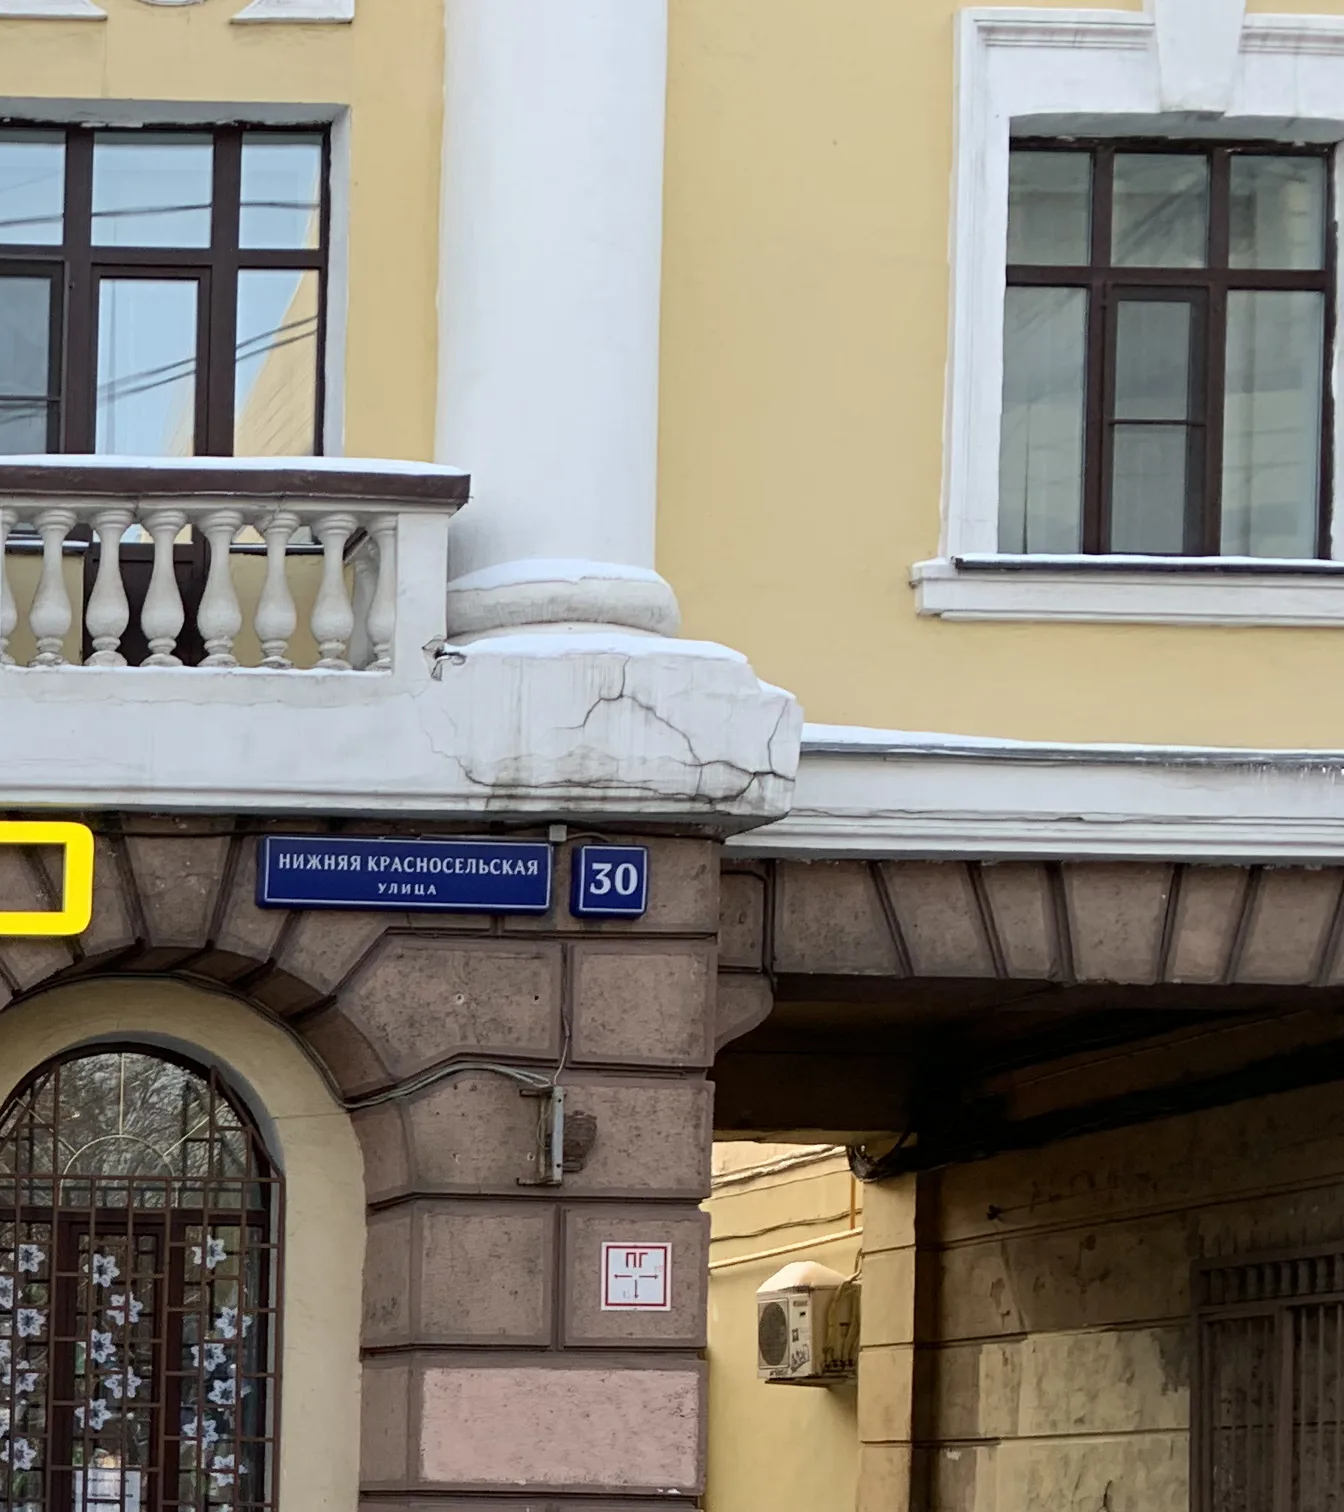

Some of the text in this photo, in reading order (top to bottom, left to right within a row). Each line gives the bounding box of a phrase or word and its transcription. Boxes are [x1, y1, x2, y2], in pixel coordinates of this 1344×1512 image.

[279, 853, 539, 876] НИЖНЯЯ КРАСНОСЕЛЬСКАЯ
[589, 862, 638, 895] 30
[377, 883, 437, 896] УЛИЦА
[625, 1252, 648, 1268] ПГ
